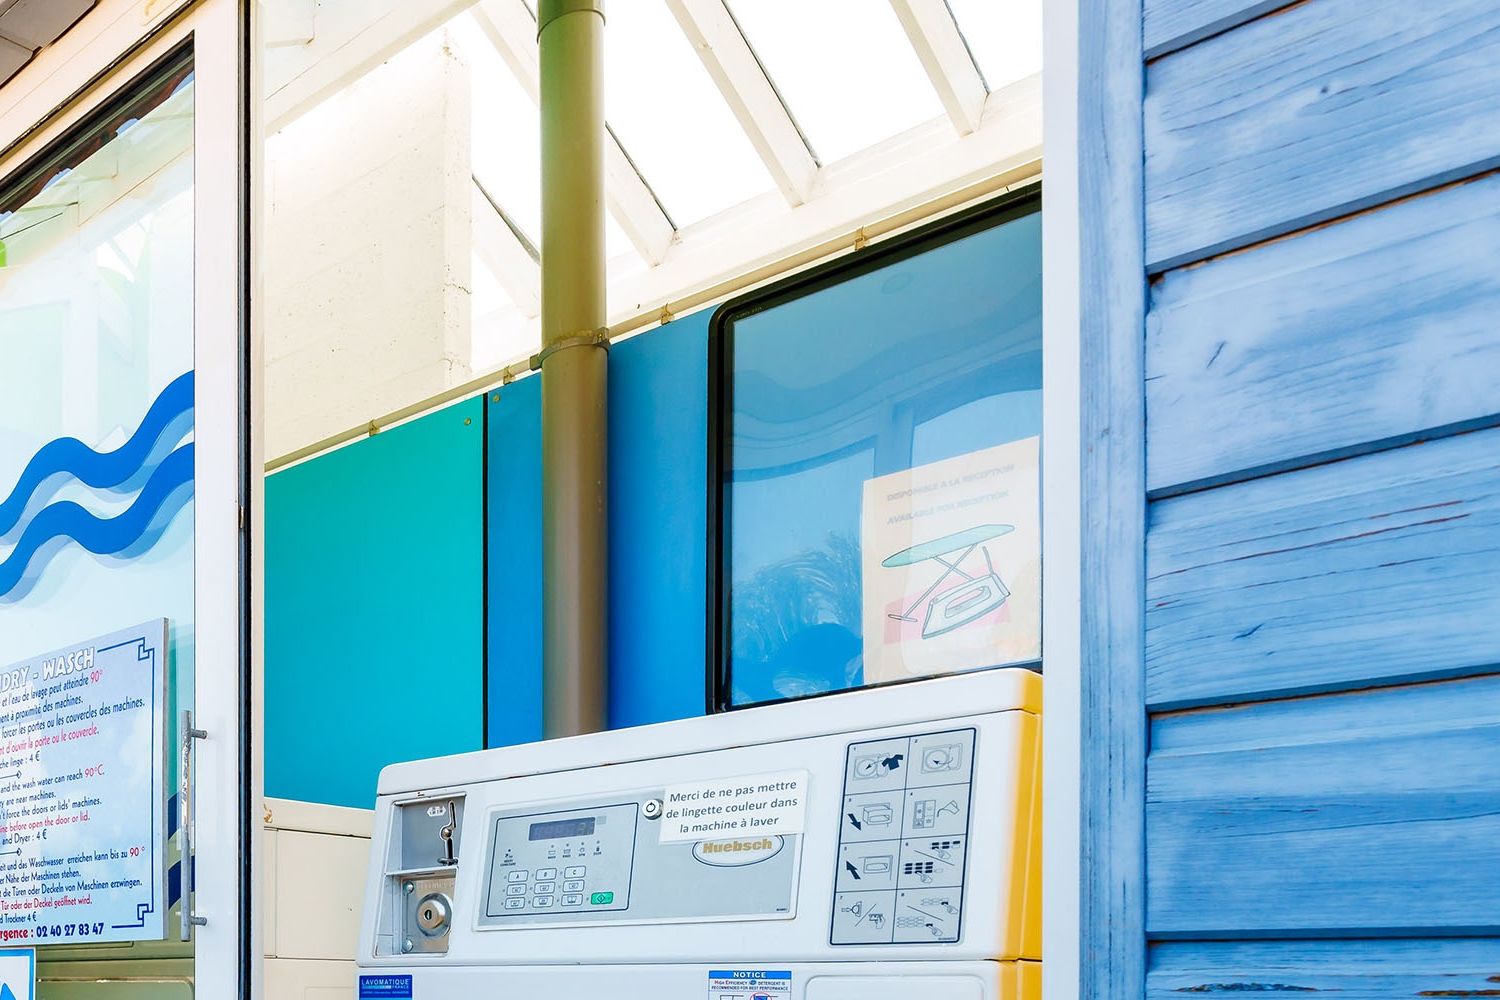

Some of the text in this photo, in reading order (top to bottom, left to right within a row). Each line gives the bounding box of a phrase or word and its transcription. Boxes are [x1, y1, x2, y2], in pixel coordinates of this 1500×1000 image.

[43, 647, 94, 681] WASCH
[670, 780, 797, 802] Merci de ne pas mettre
[666, 798, 798, 818] de lingette couleur dans
[680, 816, 779, 834] la machine à laver
[702, 838, 772, 854] Huebsch
[36, 925, 49, 937] 02
[50, 924, 61, 936] 40
[65, 923, 76, 935] 27
[78, 923, 89, 935] 83
[92, 922, 104, 934] 47
